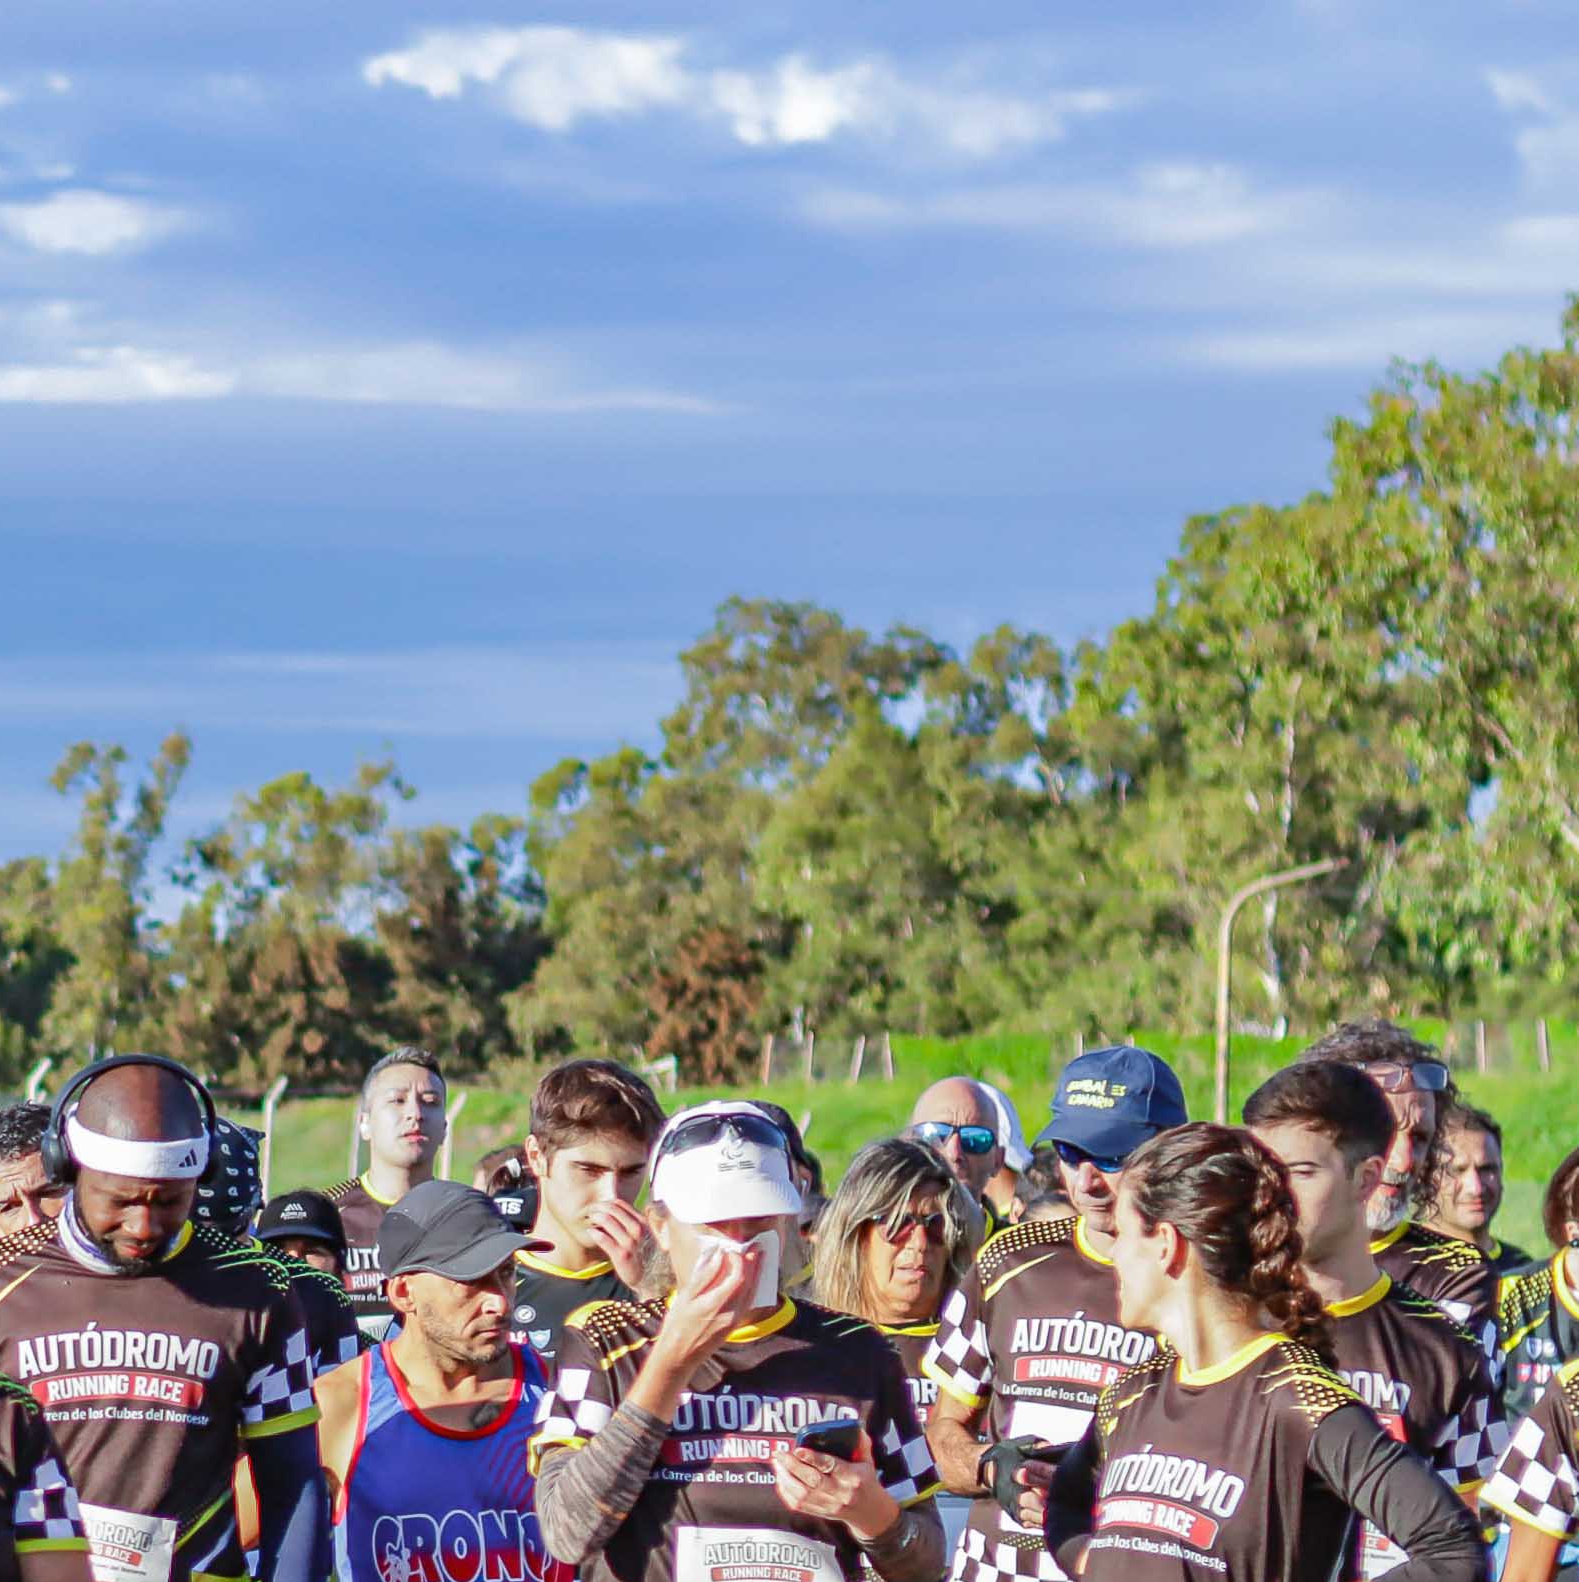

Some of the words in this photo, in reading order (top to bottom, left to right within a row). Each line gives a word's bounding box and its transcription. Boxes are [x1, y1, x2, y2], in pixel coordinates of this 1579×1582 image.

[18, 1322, 219, 1379] AUTÓDROMO
[1029, 1359, 1100, 1382] RUNNING
[47, 1374, 129, 1401] RUNNING
[134, 1376, 184, 1402] RACE
[1011, 1384, 1043, 1397] Carrera
[1045, 1386, 1058, 1399] de
[1060, 1388, 1076, 1401] los
[71, 1407, 86, 1421] de
[88, 1407, 104, 1420] los
[104, 1406, 143, 1420] Clubes
[146, 1408, 163, 1421] del
[165, 1410, 209, 1425] Noroeste
[681, 1438, 770, 1462] RUNNING
[708, 1470, 723, 1484] de
[725, 1470, 744, 1485] los
[1156, 1505, 1196, 1537] RACE
[704, 1536, 821, 1569] AUTÓDROMO
[722, 1566, 771, 1580] RUNNING
[774, 1567, 802, 1581] RACE
